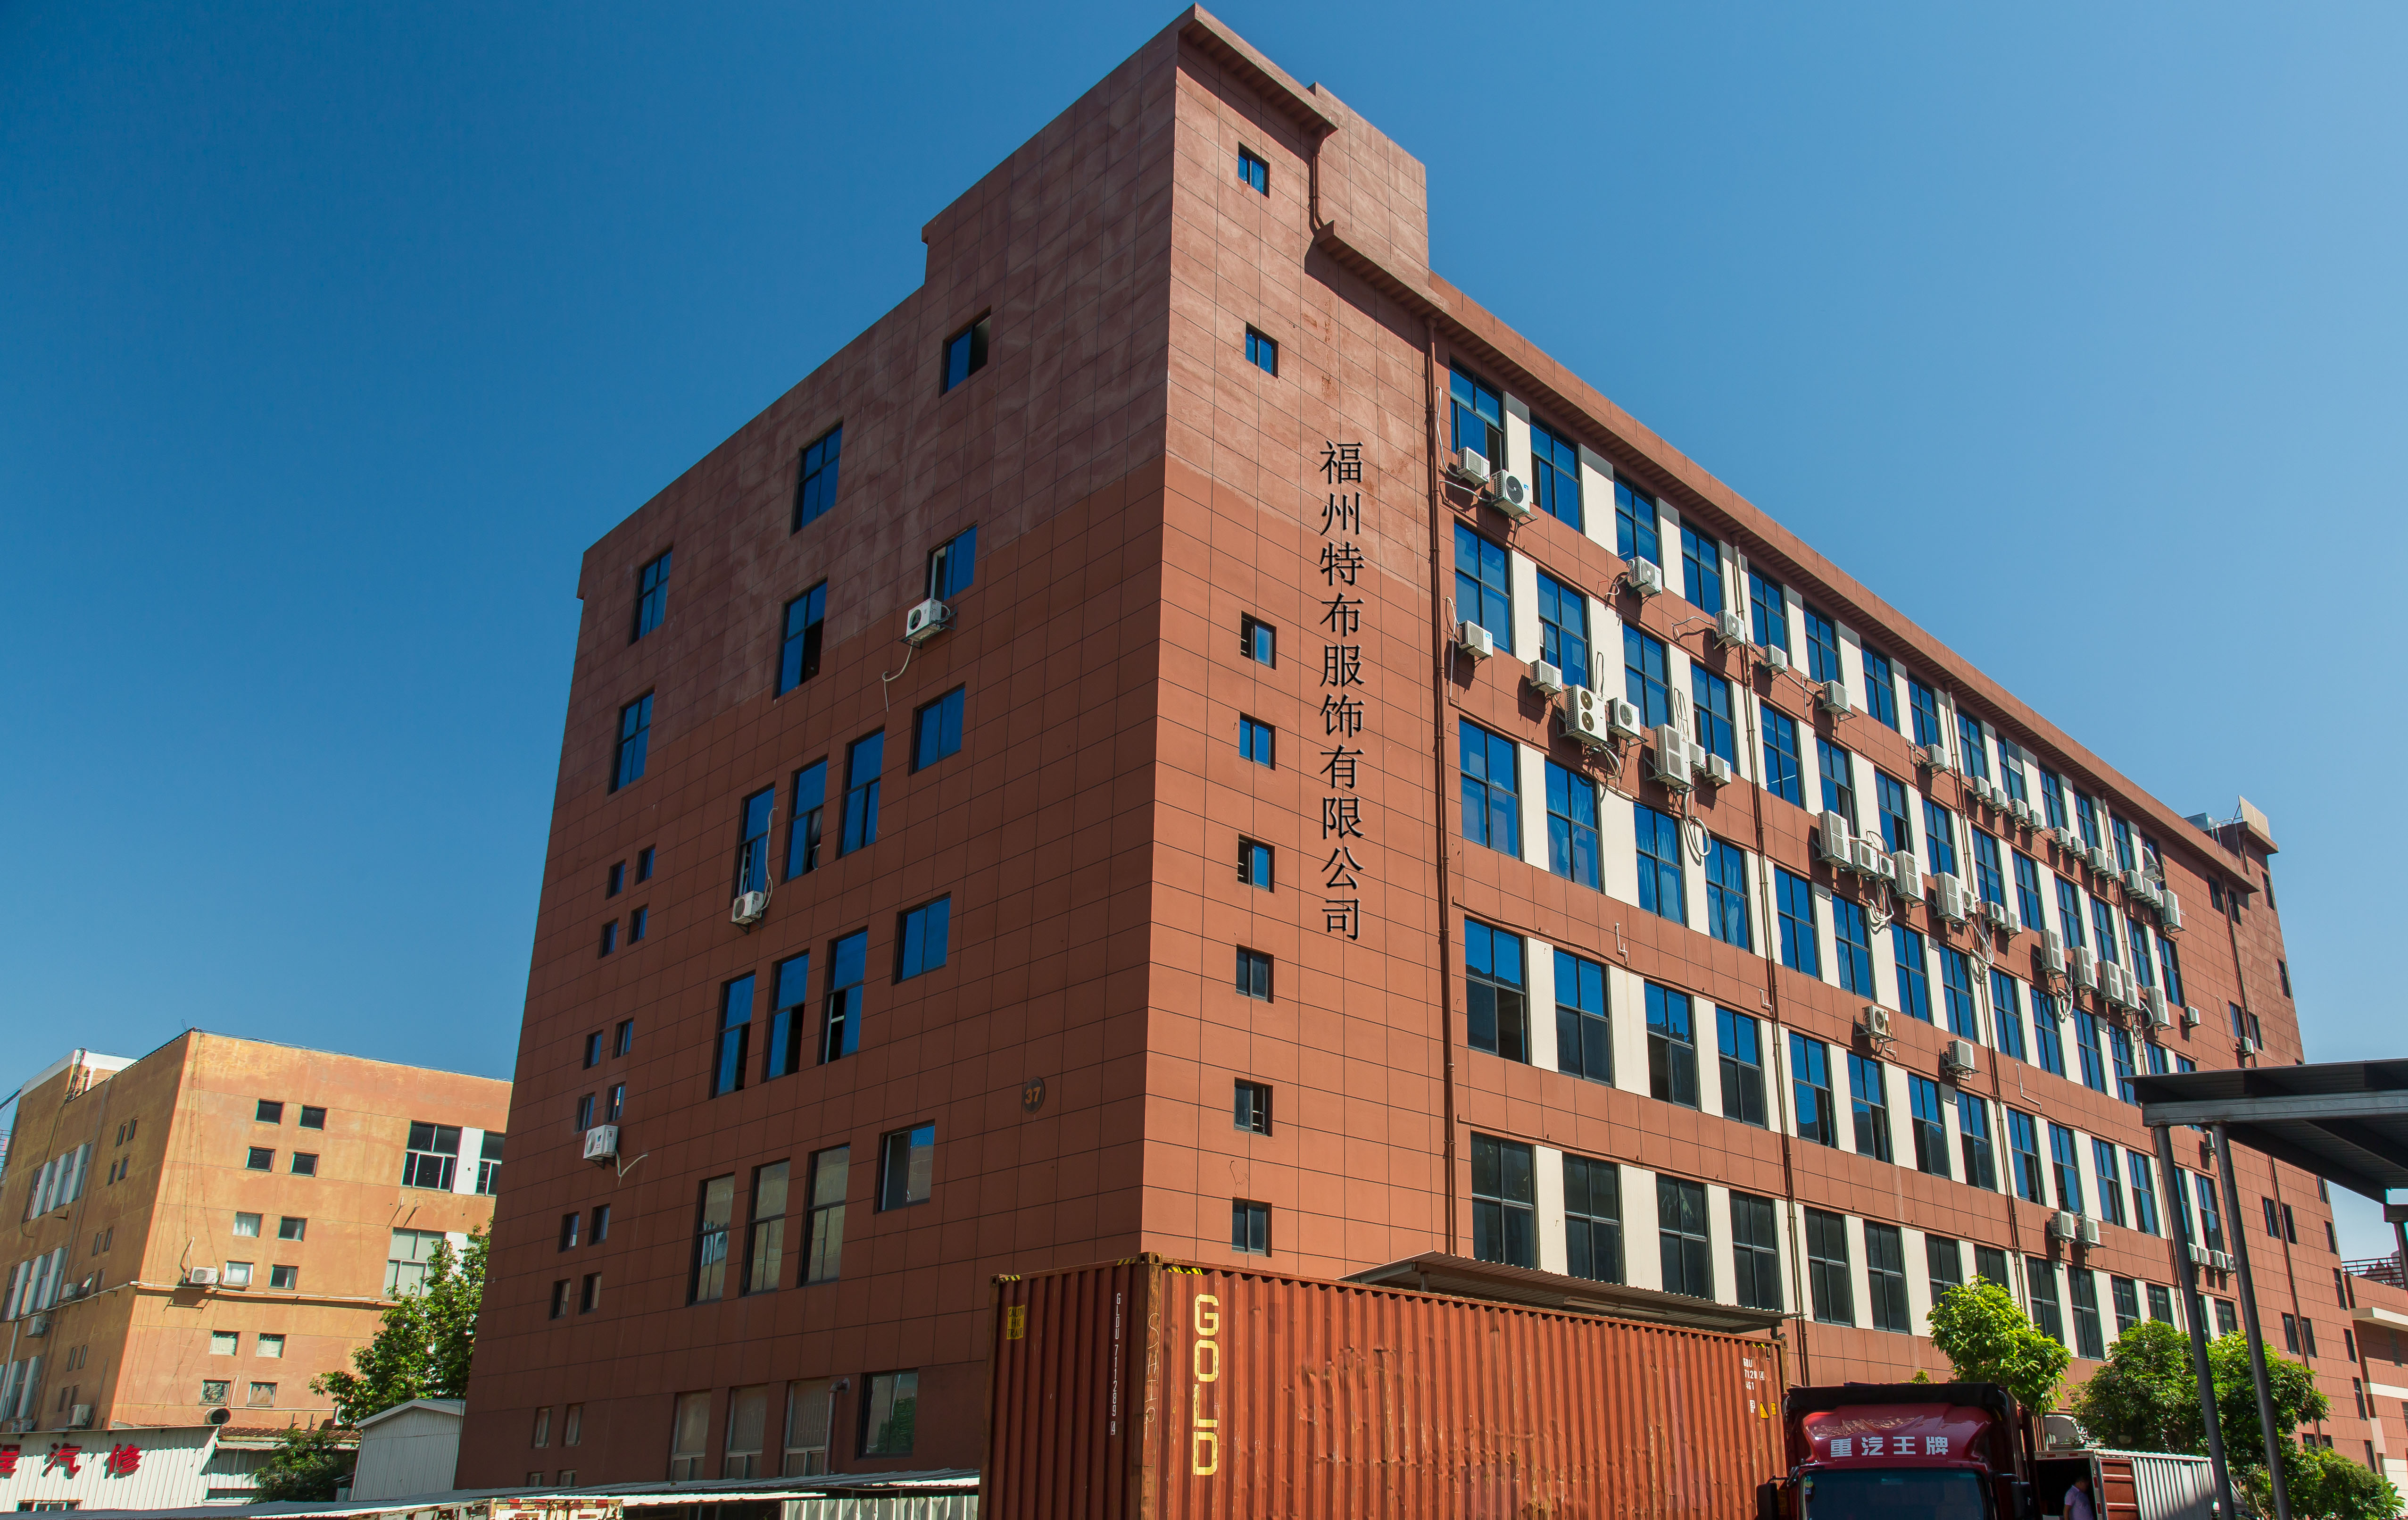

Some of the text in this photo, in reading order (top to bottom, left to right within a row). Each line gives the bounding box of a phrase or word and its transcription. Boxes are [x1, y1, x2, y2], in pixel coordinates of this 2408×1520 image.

[1025, 1086, 1041, 1104] 37
[1193, 1293, 1220, 1476] GOLD
[1830, 1436, 1949, 1457] 重汽王牌
